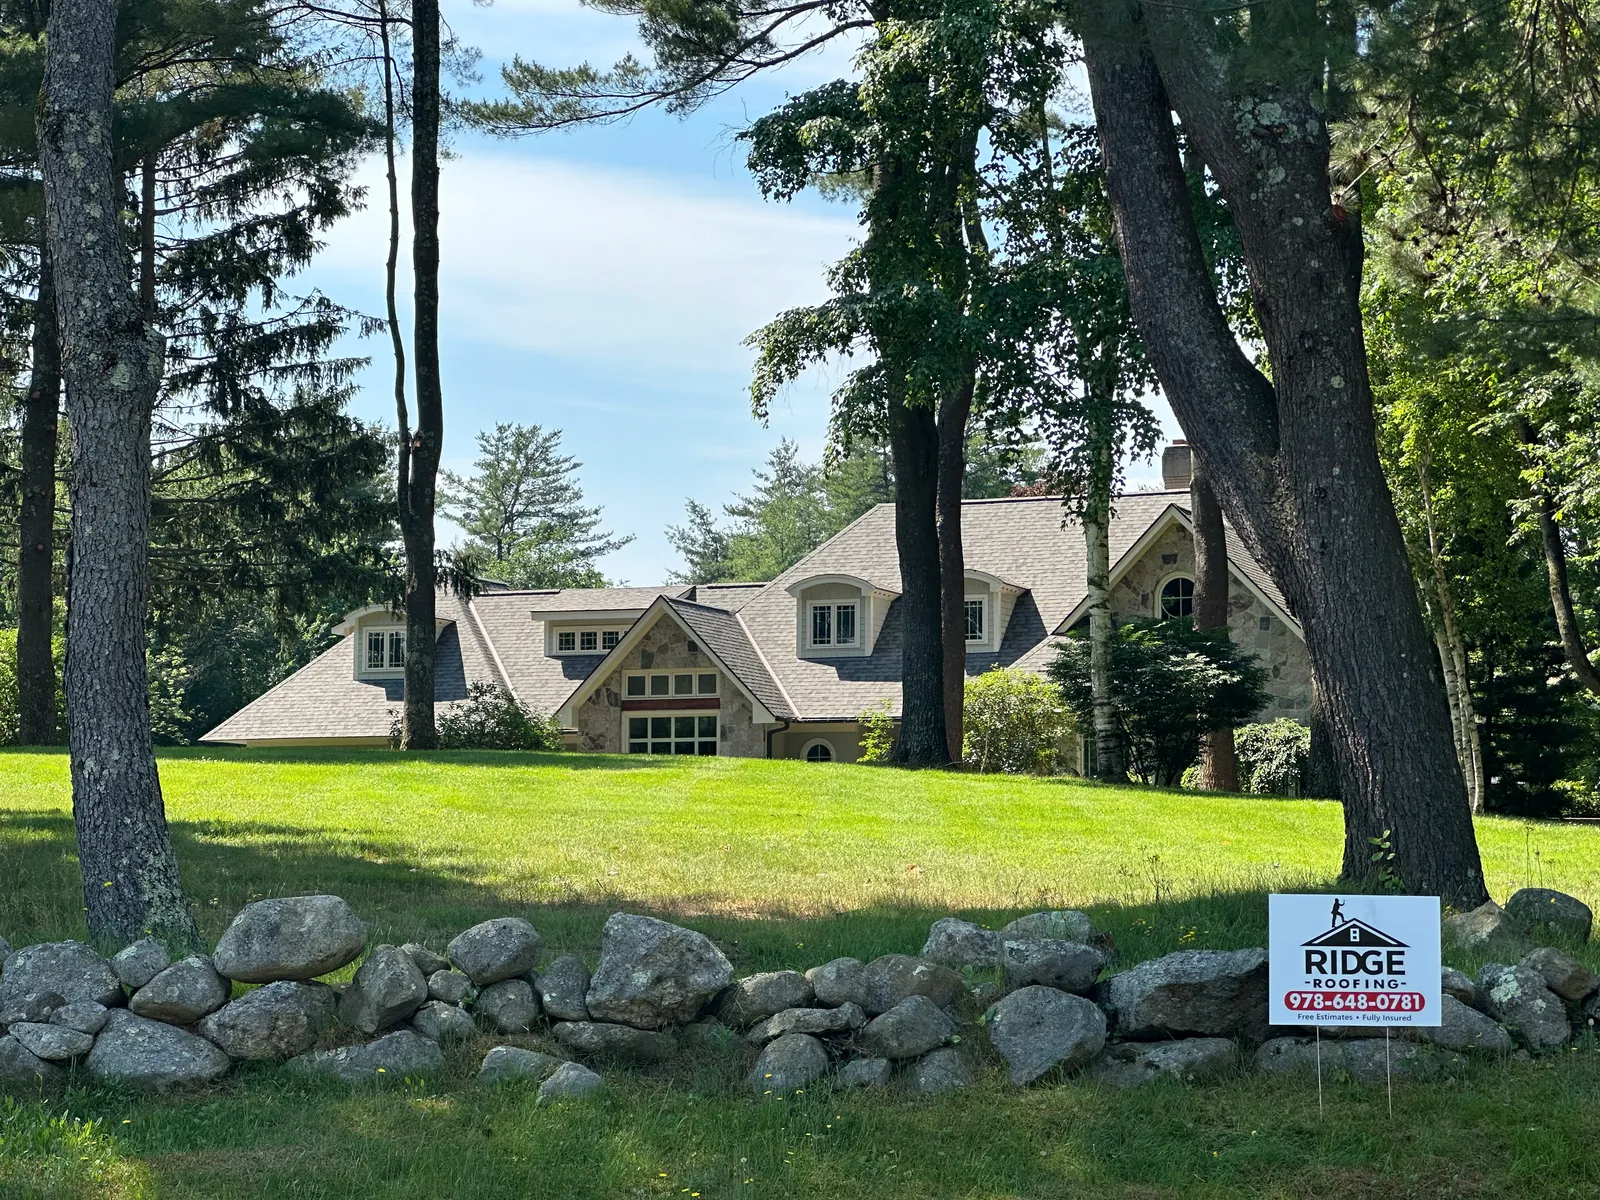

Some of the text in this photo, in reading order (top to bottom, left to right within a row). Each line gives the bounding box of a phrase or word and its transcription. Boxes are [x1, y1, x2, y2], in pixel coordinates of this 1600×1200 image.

[1305, 950, 1406, 976] RIDGE
[1289, 992, 1420, 1010] 978-648-0781
[1297, 1013, 1412, 1023] Free Estimates Fully Insured
